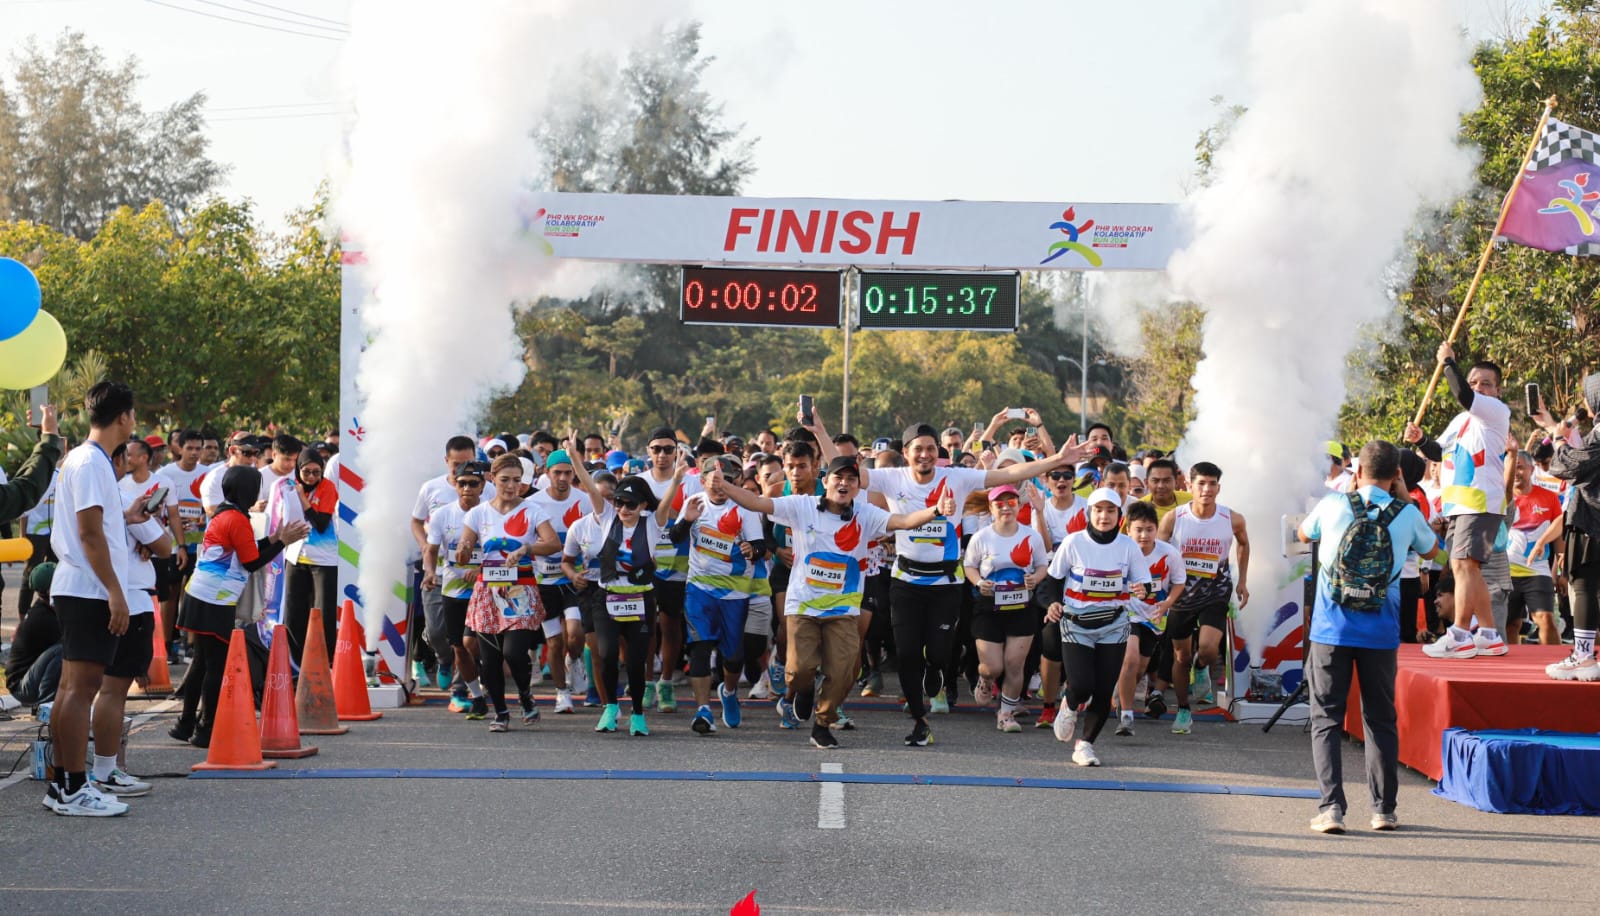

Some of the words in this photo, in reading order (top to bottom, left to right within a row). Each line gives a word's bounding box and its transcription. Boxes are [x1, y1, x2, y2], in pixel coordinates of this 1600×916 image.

[723, 207, 920, 256] FINISH
[685, 280, 817, 313] 0:00:02
[865, 286, 997, 315] 0:15:37
[701, 536, 728, 550] UM-186
[1185, 560, 1213, 569] UM-218
[489, 569, 509, 577] IF-131
[1090, 580, 1116, 588] IF-134
